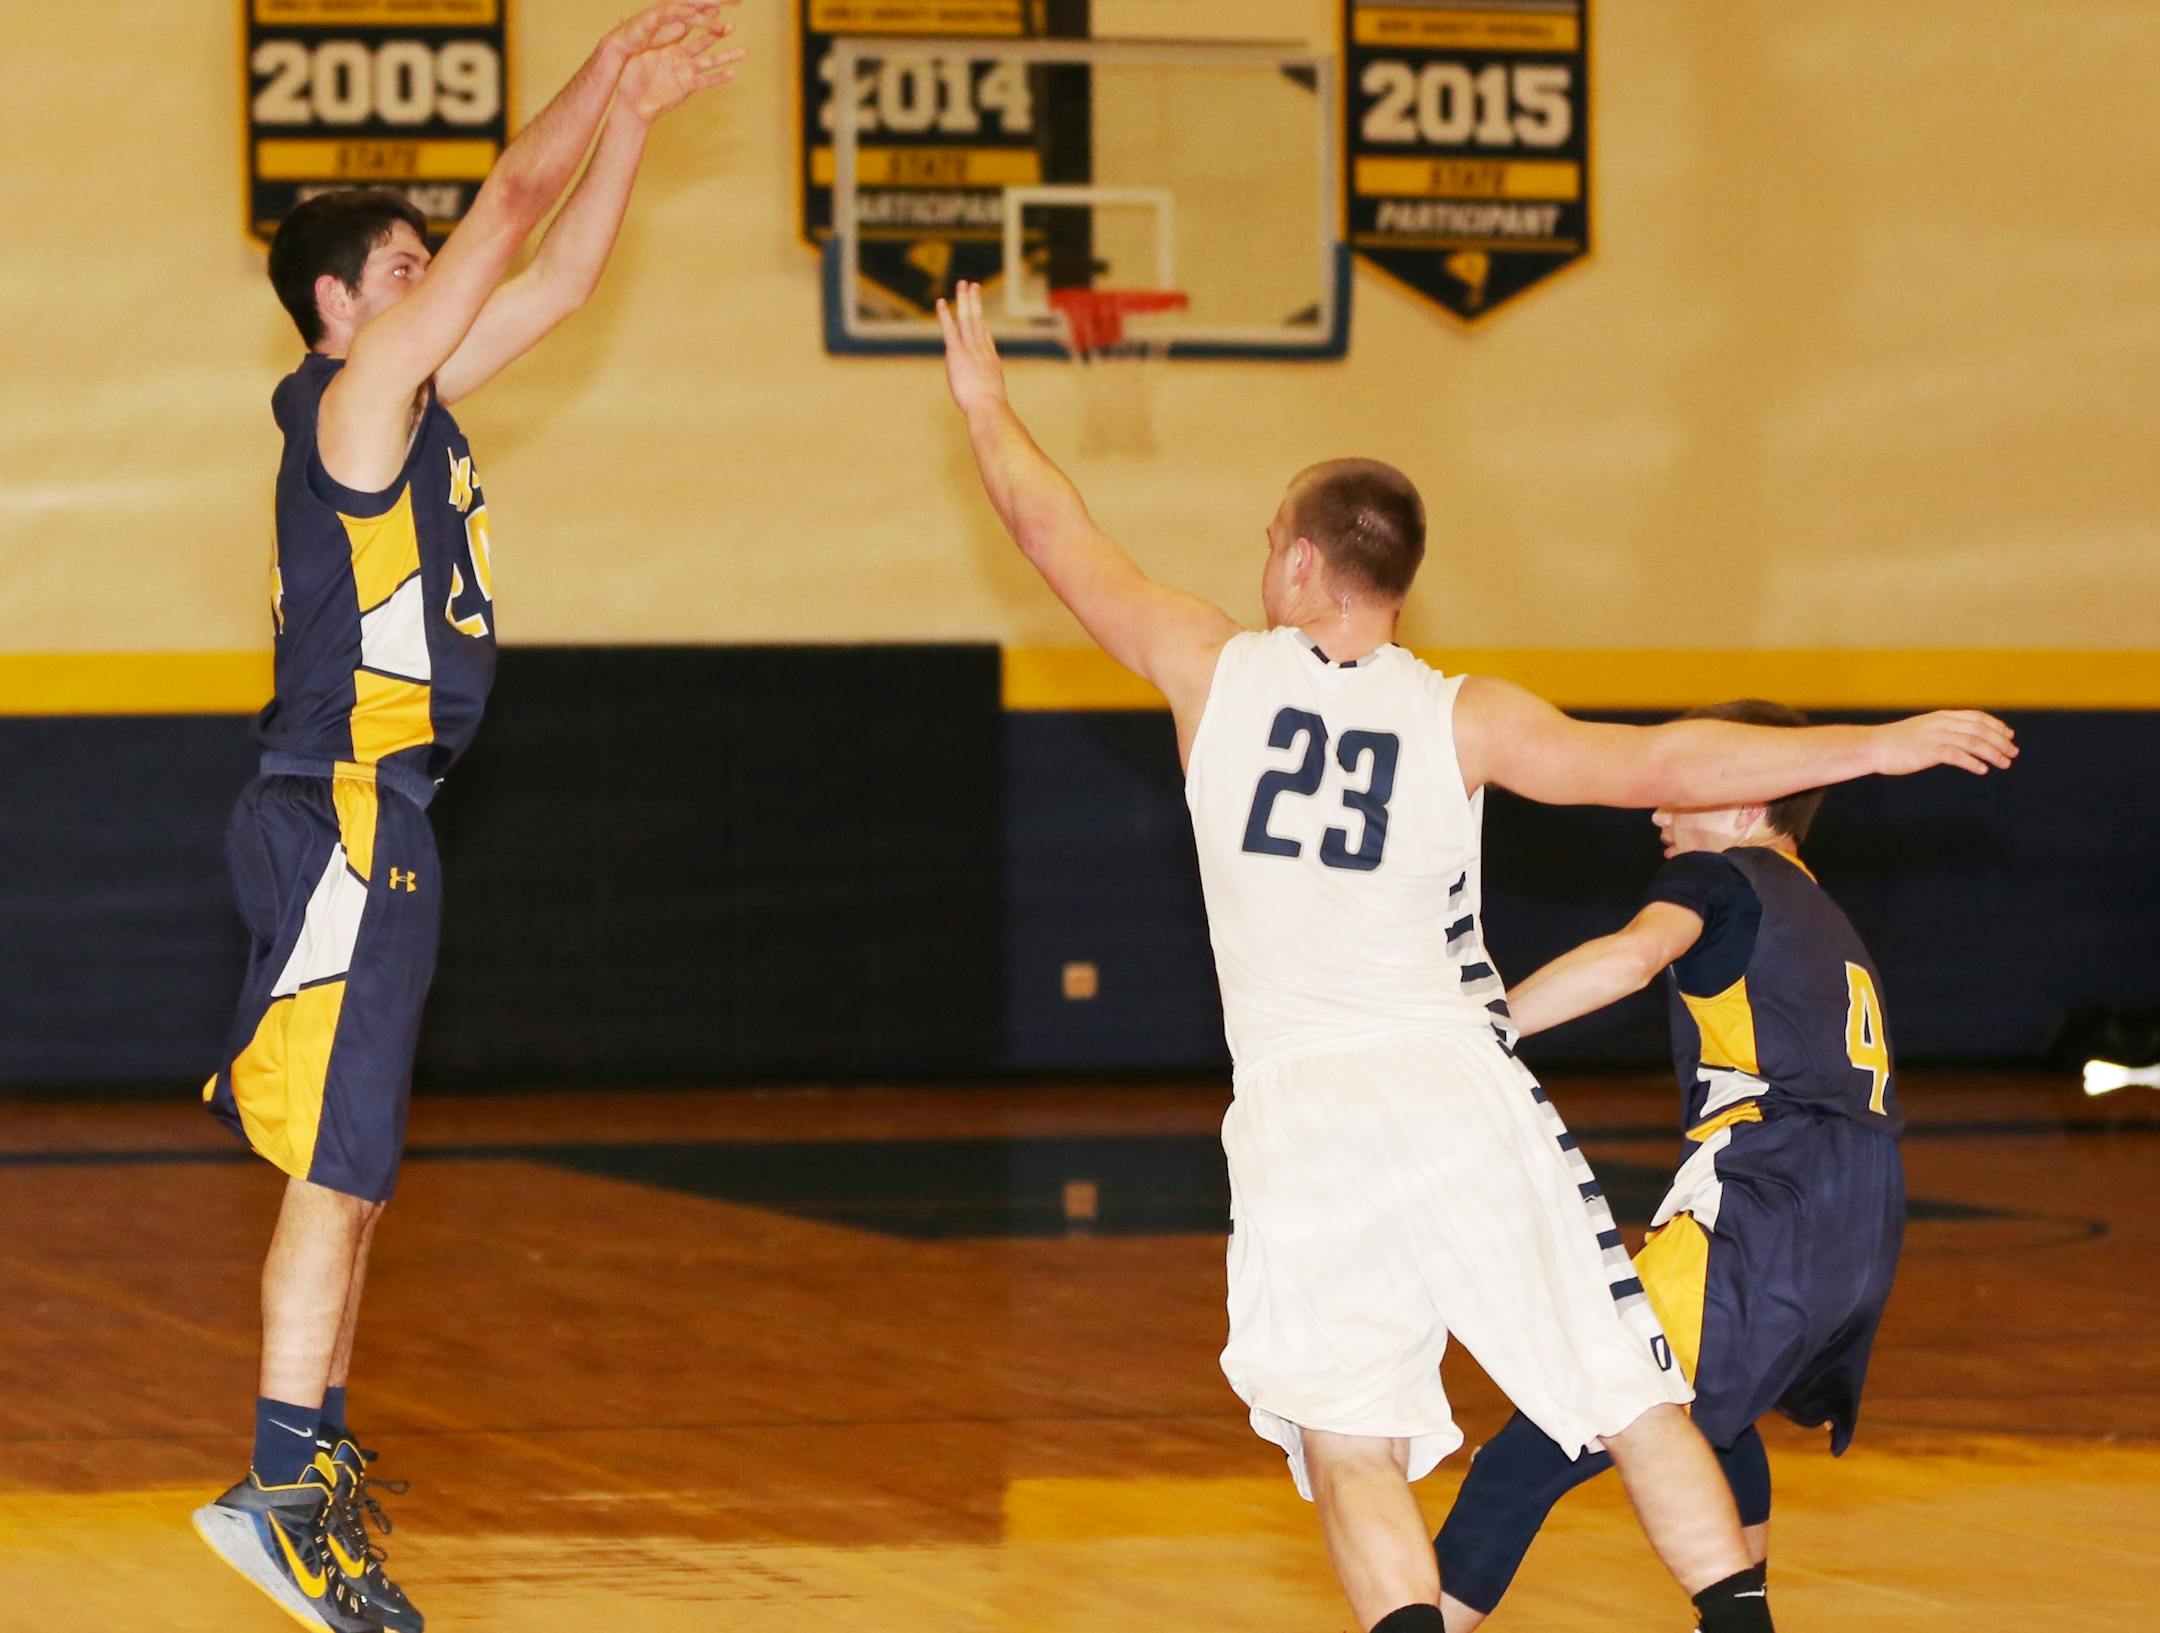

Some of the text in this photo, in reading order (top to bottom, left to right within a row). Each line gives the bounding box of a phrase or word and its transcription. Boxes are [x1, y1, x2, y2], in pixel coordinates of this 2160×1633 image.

[252, 39, 499, 125] 2009
[818, 48, 1033, 133] 2014
[1360, 59, 1573, 147] 2015
[1374, 201, 1560, 236] PARTICIPANT
[1241, 705, 1400, 873] 23
[1844, 960, 1890, 1116] 4
